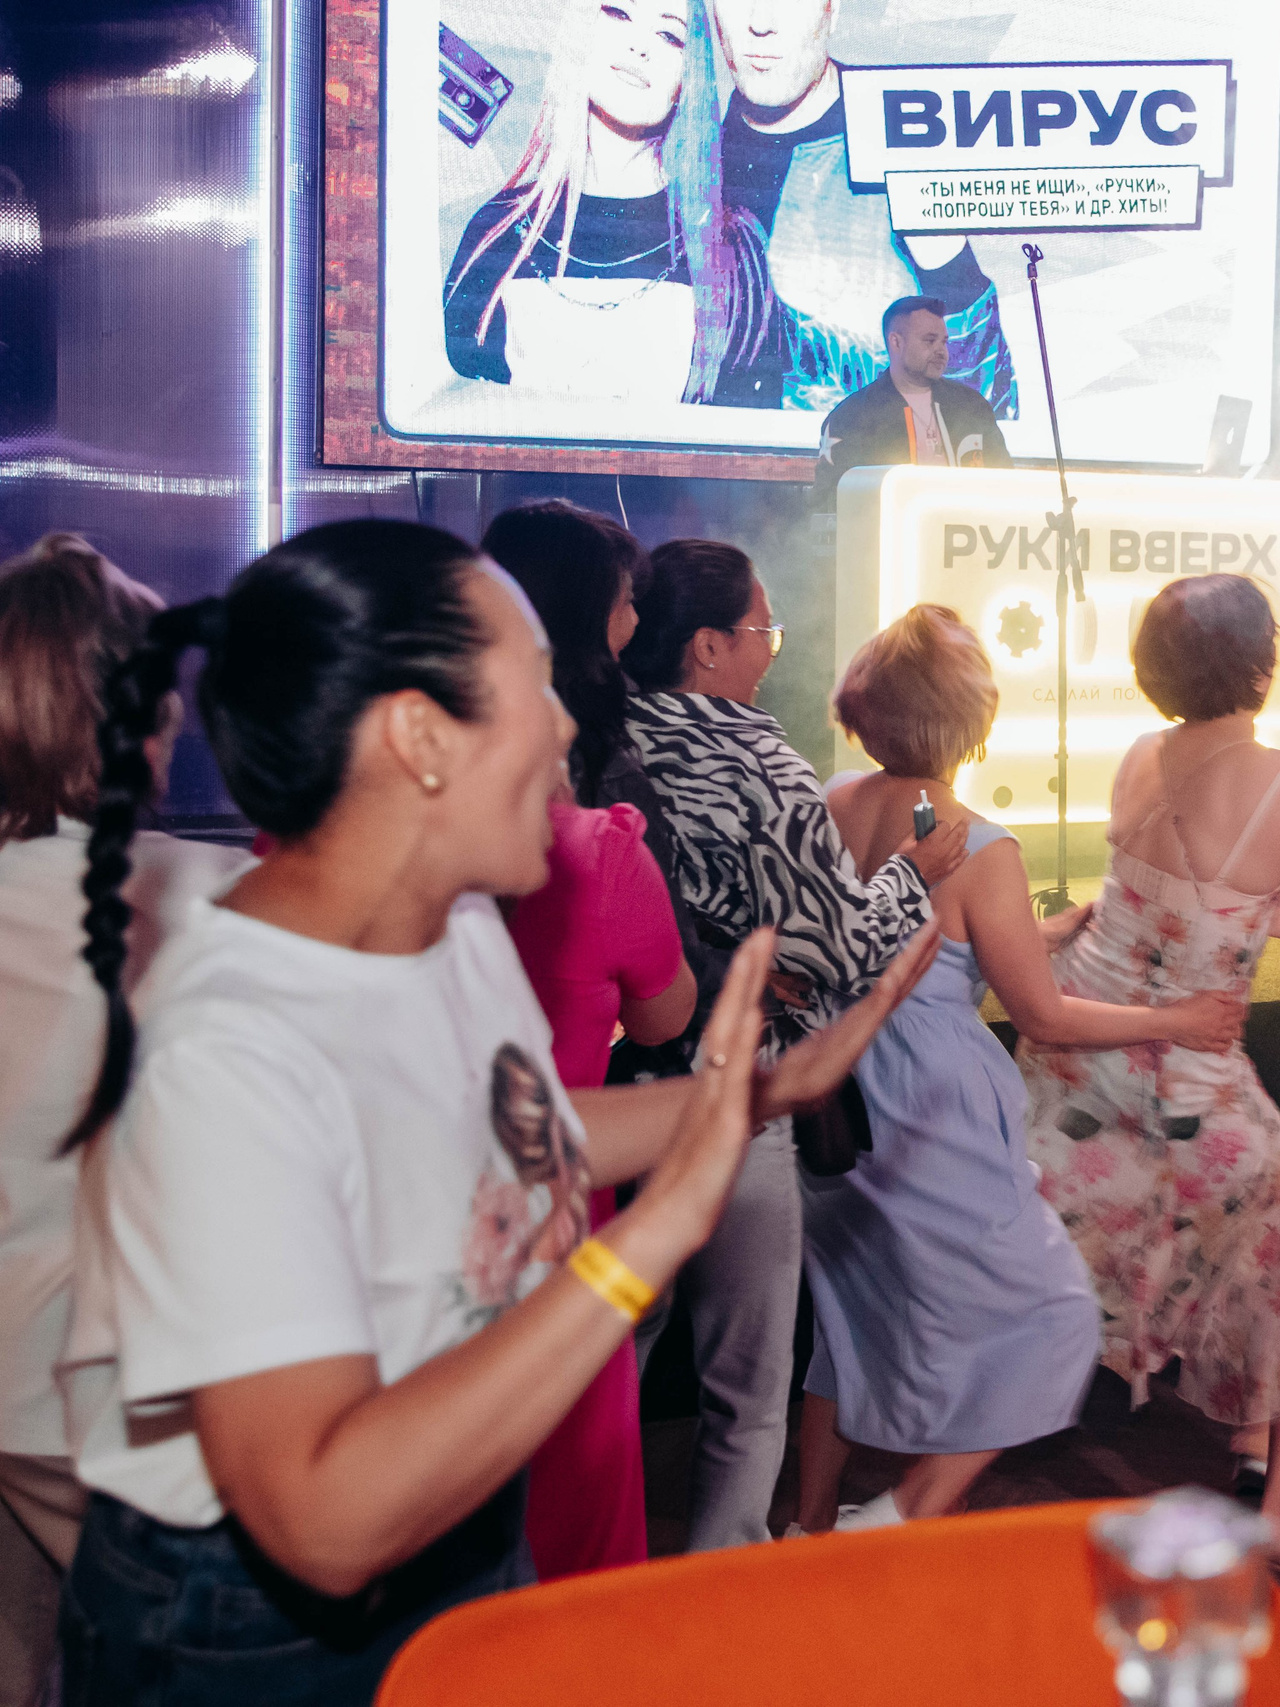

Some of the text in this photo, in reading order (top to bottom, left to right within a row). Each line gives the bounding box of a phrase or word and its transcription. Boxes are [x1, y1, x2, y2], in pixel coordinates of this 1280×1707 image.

[883, 89, 1197, 148] ВИРУС
[920, 177, 1171, 197] «ТЫ МЕНЯ НЕ ИЩИ», «РУЧКИ»,
[921, 198, 1168, 219] «ПОПРОШУ ТЕБЯ» И ДР. ХИТЫ!
[1032, 685, 1100, 703] СДЛАЙ
